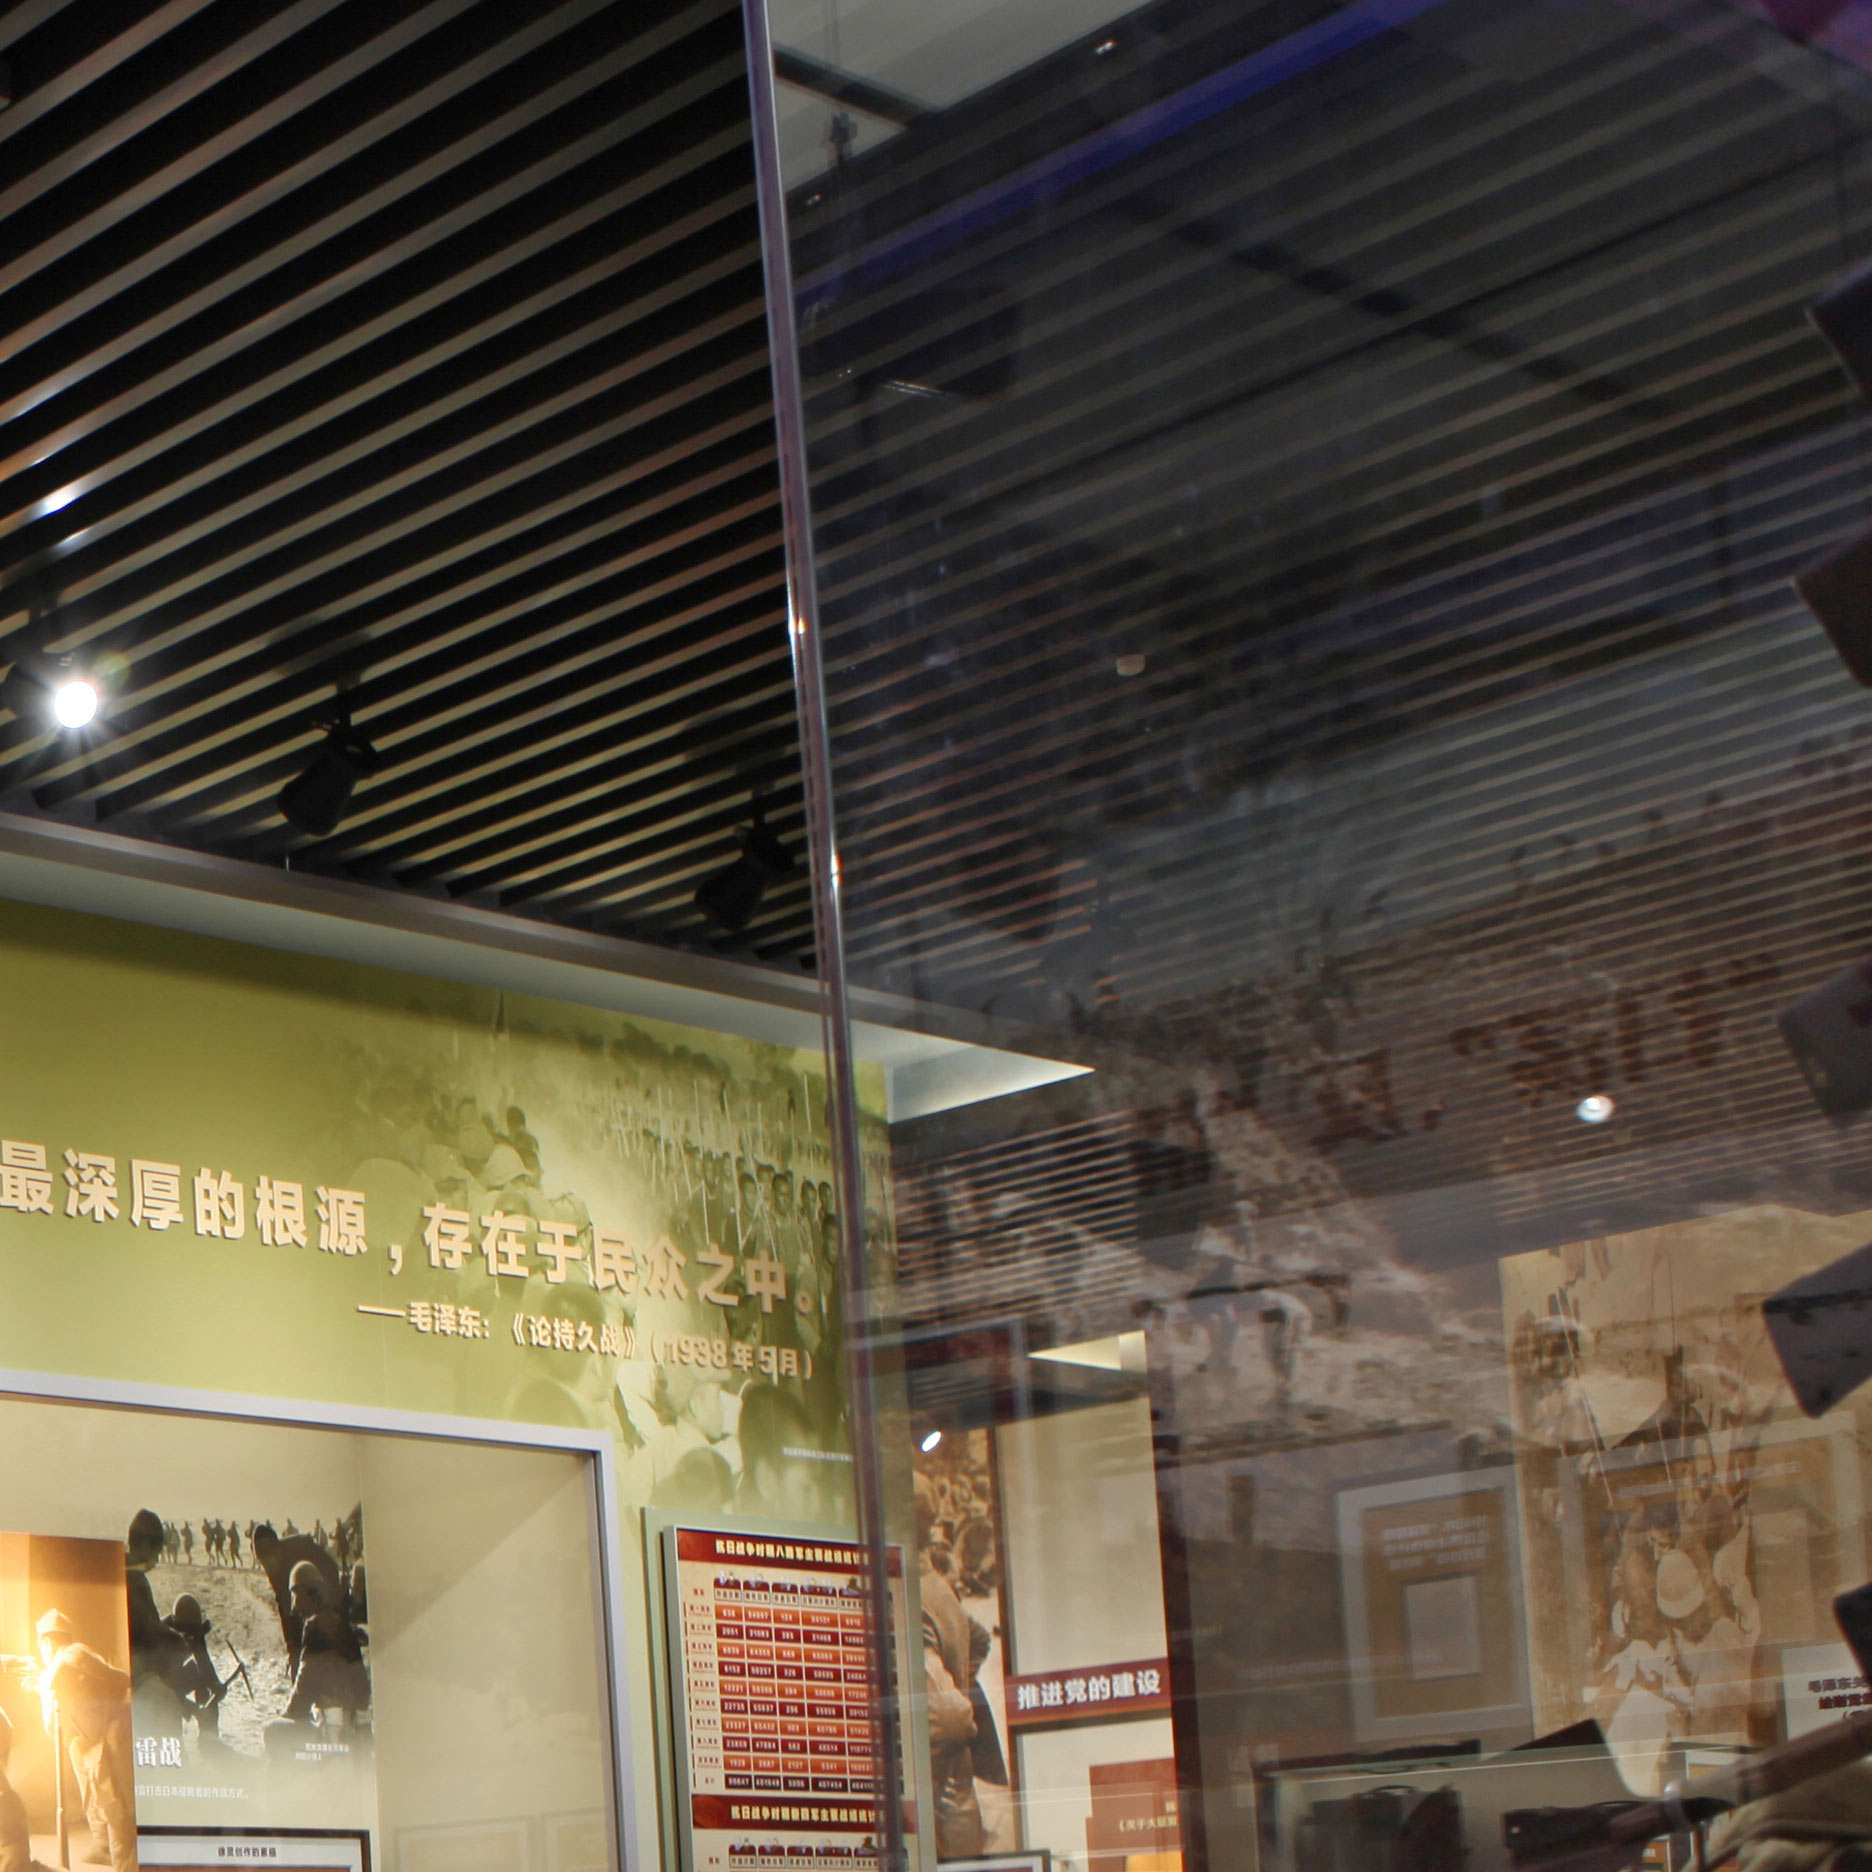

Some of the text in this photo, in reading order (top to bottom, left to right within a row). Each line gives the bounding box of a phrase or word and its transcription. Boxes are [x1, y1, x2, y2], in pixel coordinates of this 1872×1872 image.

[1017, 1669, 1161, 1711] 推进党的建设
